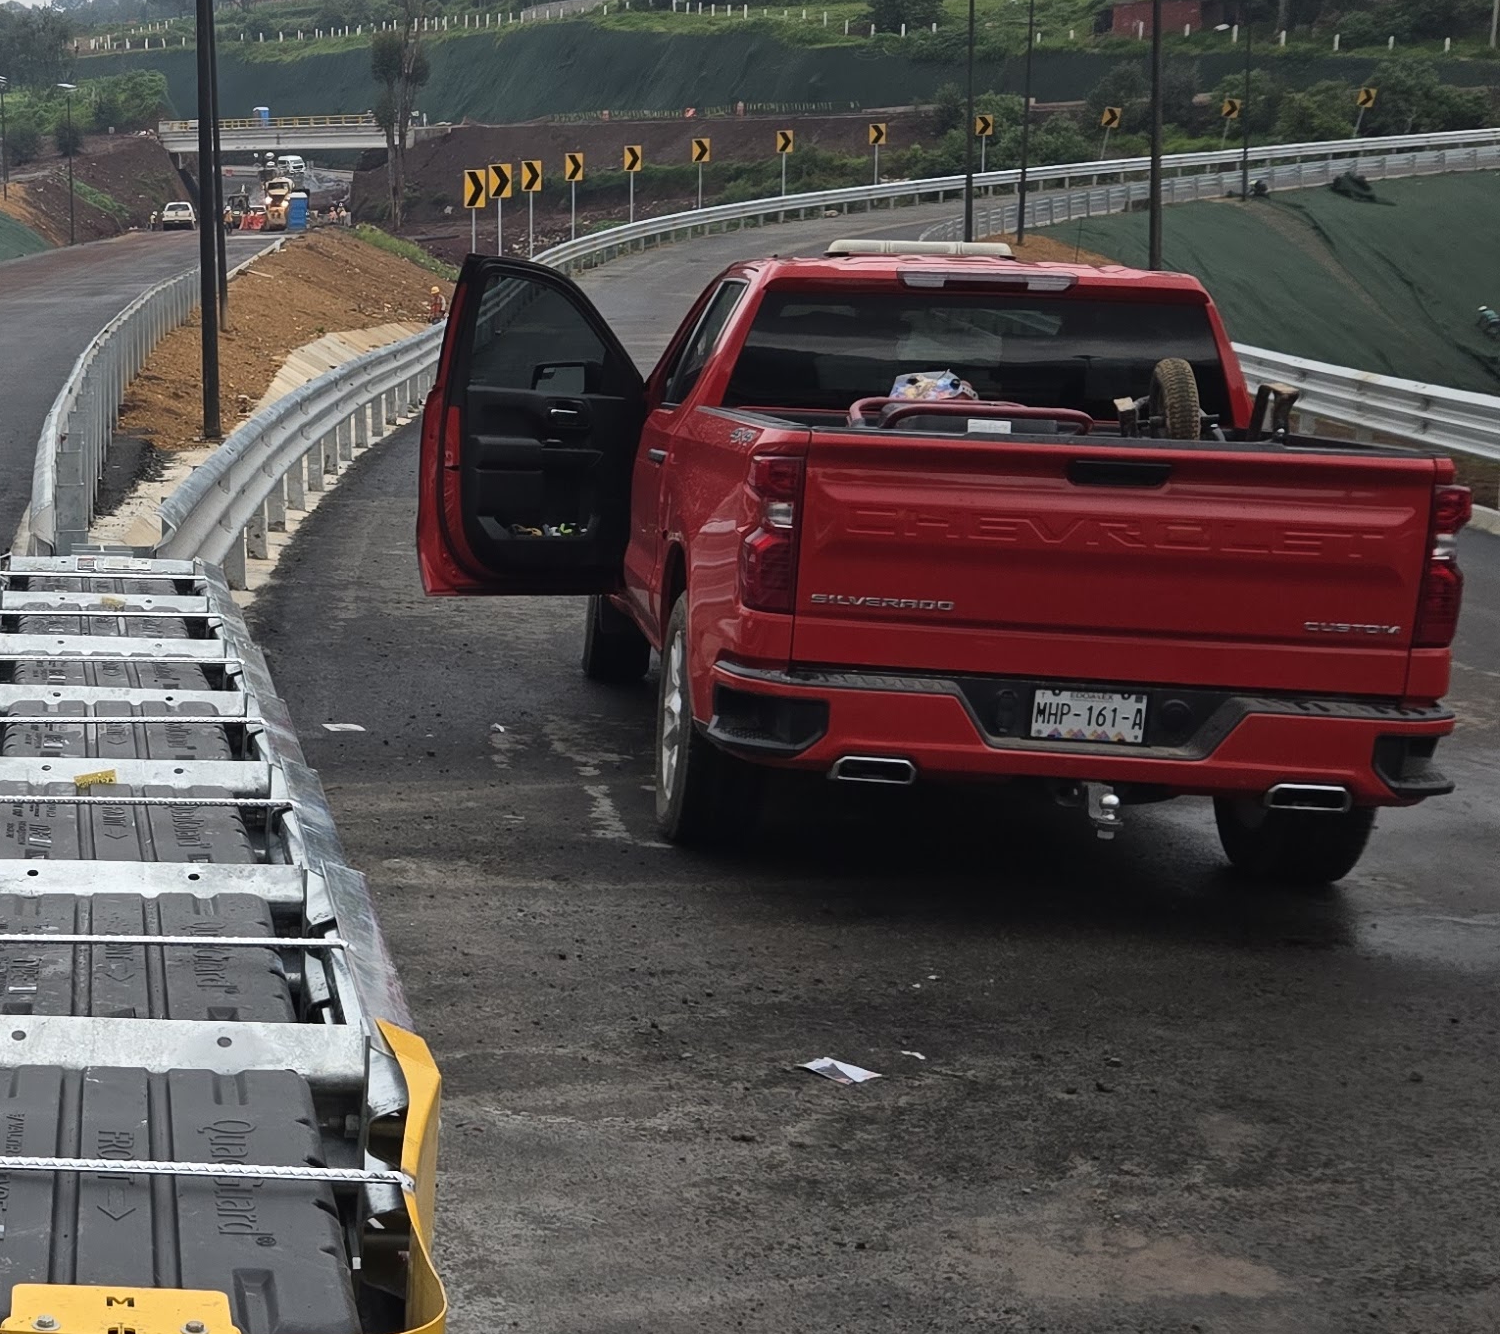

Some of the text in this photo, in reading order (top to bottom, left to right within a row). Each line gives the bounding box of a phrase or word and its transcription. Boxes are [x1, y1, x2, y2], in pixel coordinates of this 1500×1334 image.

[845, 506, 1385, 558] CHEVROLET
[810, 593, 955, 611] SILVERADO
[1303, 621, 1401, 634] CUSTOM
[1034, 701, 1143, 730] MHP-161-A
[97, 1130, 135, 1185] FROT
